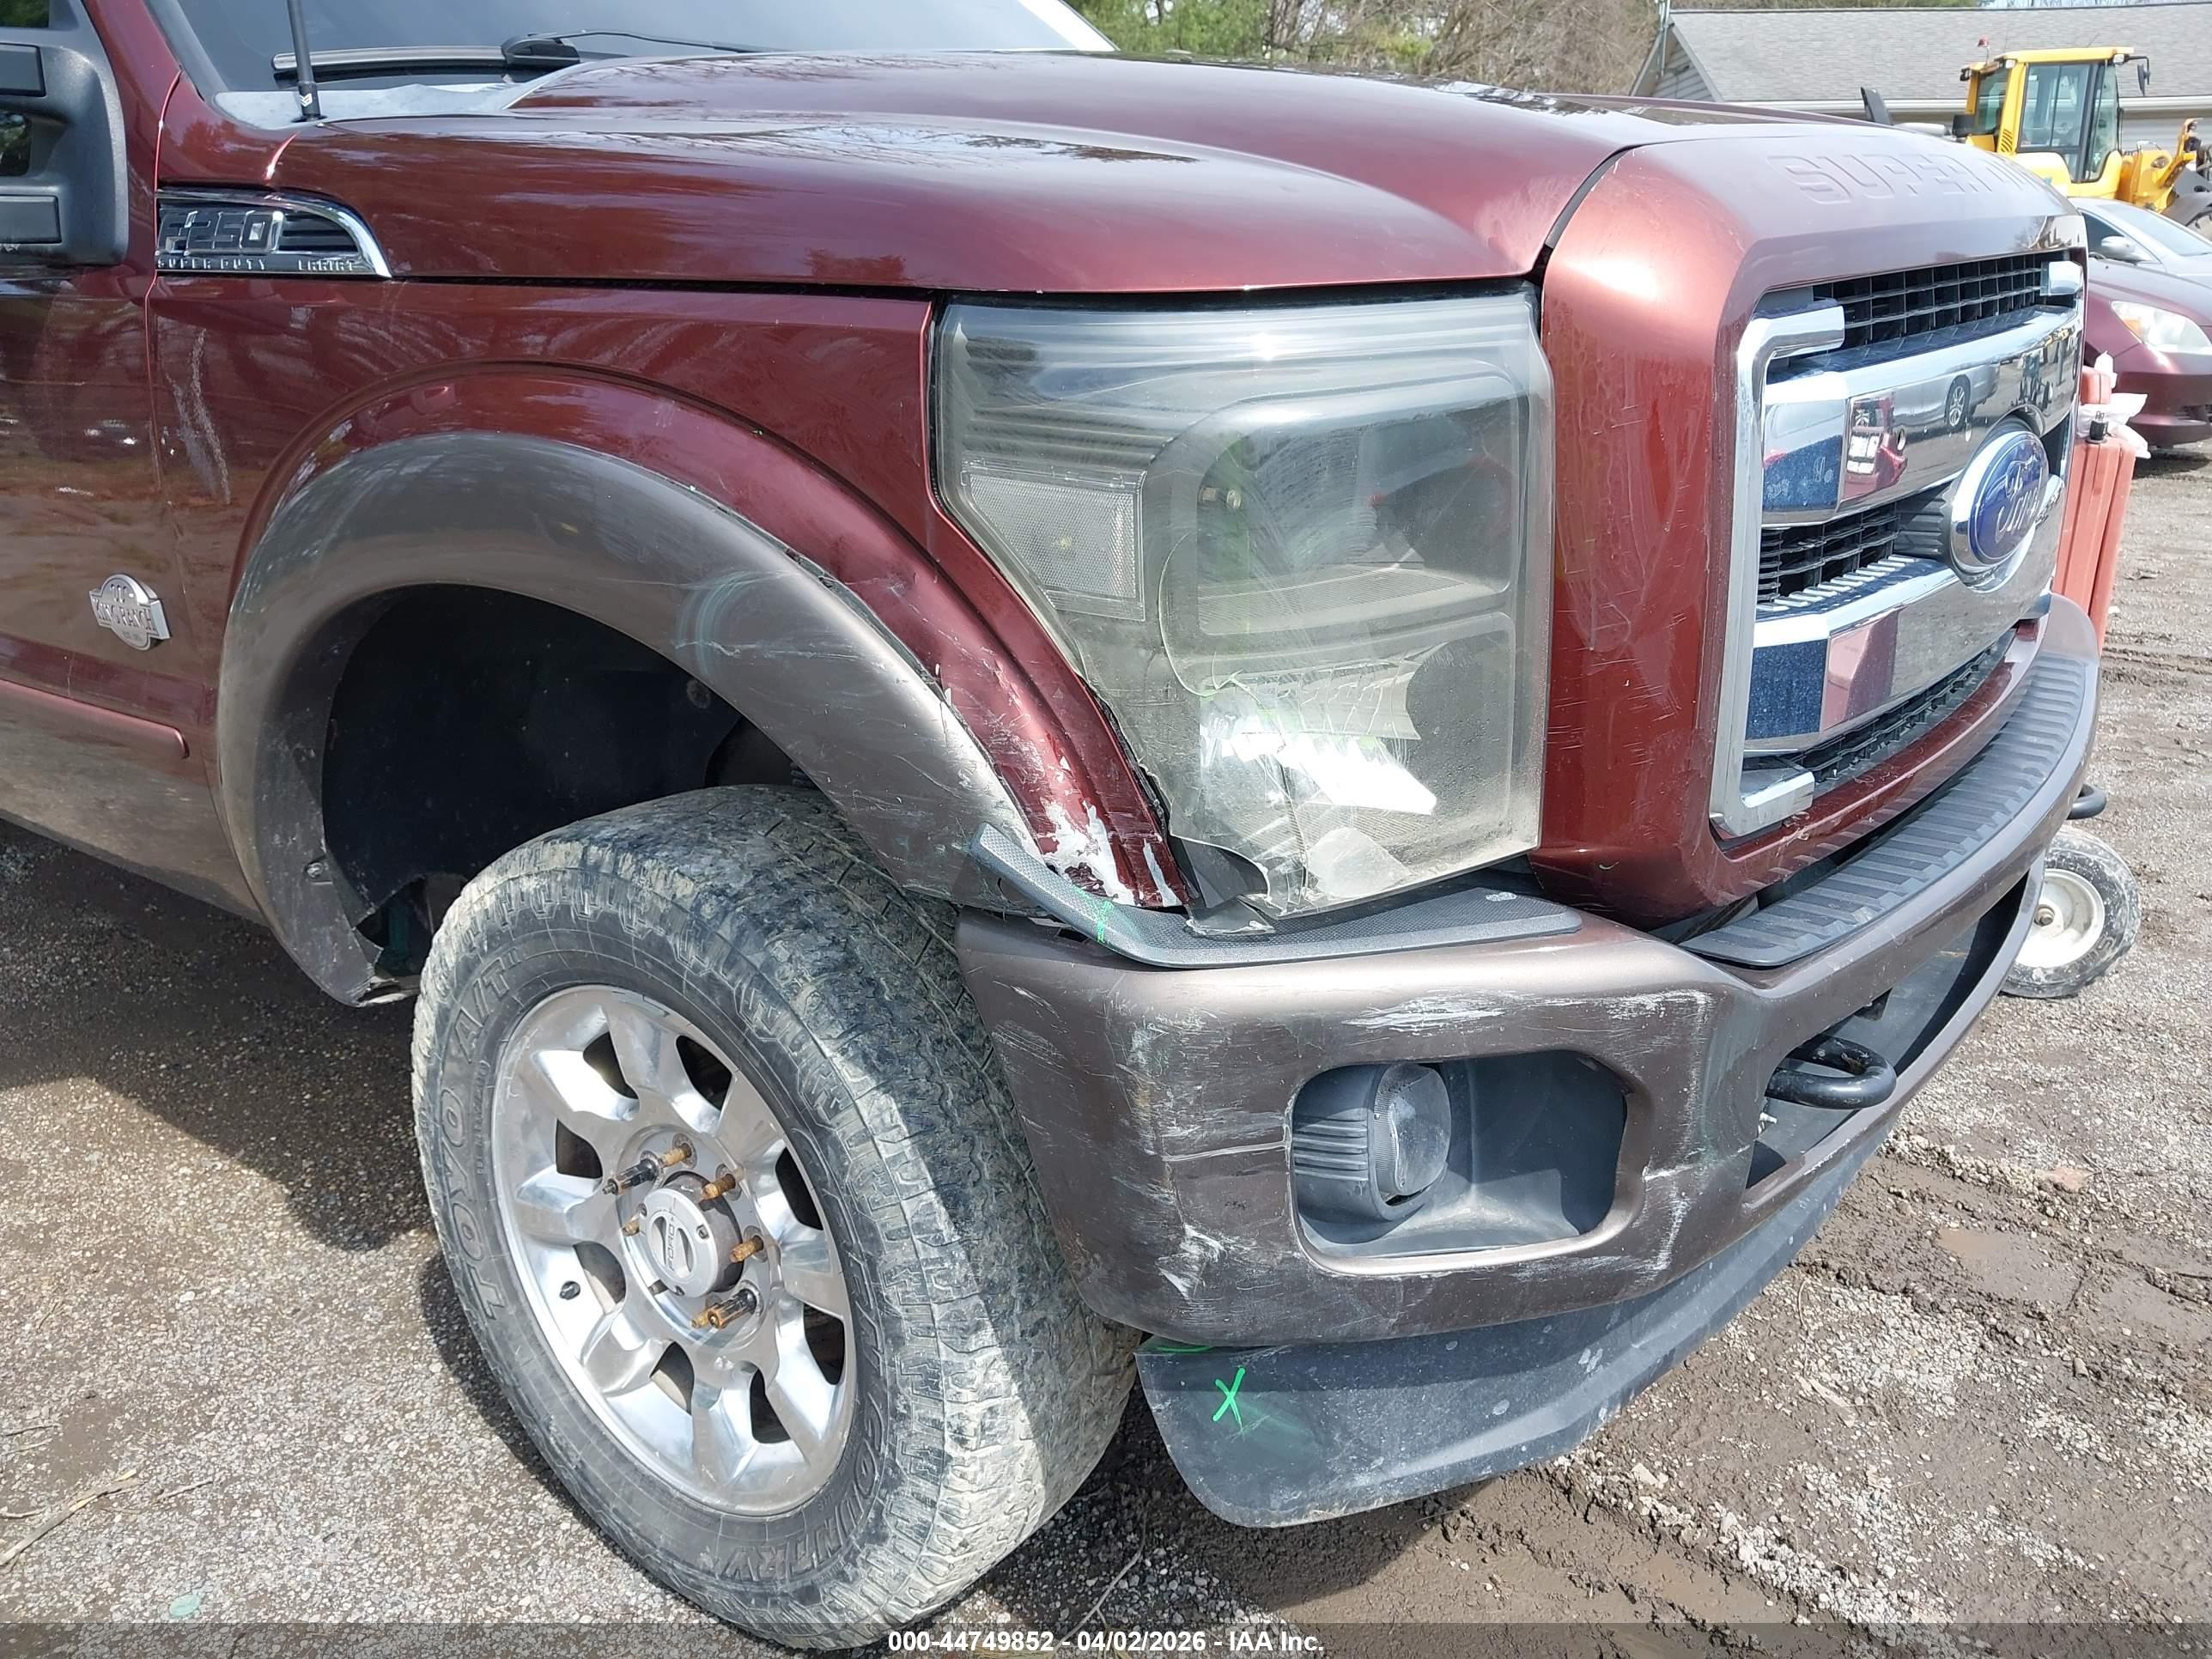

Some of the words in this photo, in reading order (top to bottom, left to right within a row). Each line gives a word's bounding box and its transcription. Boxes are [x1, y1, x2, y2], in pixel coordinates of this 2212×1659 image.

[1765, 154, 1994, 204] SUPER
[157, 258, 212, 269] SUPER
[220, 258, 266, 270] DUTY
[440, 1087, 507, 1321] TOYO
[666, 1223, 676, 1272] FORD
